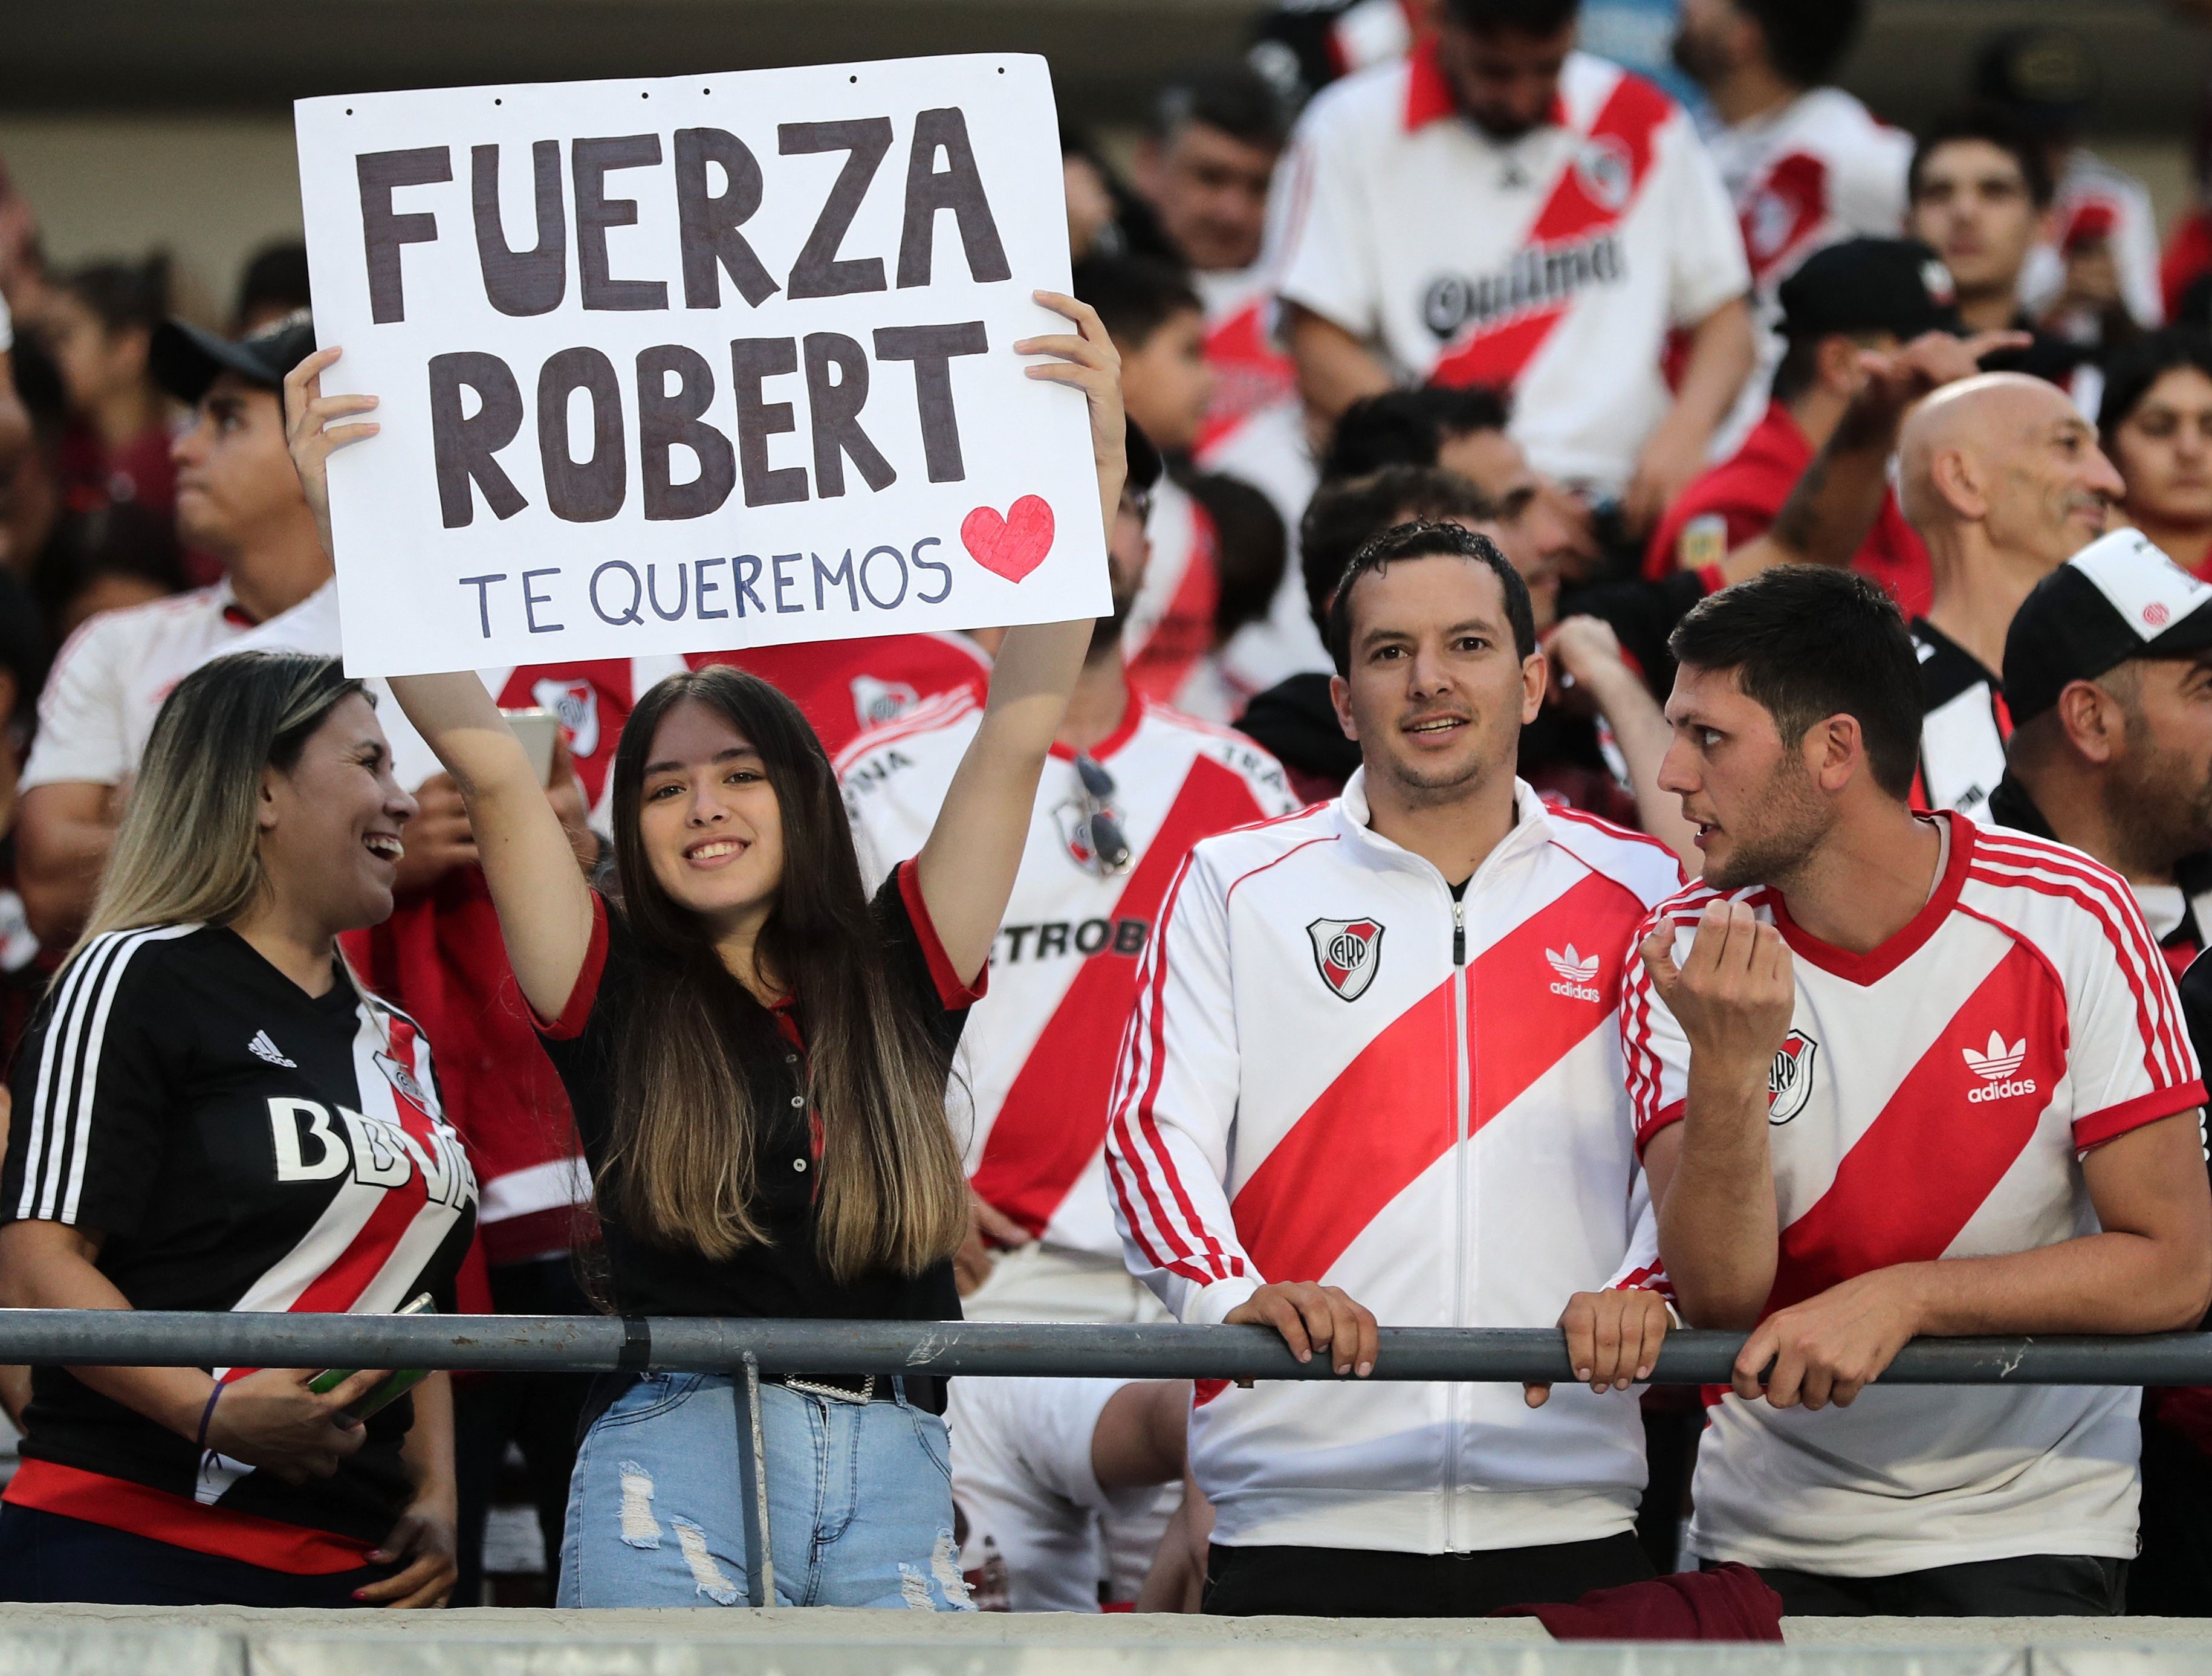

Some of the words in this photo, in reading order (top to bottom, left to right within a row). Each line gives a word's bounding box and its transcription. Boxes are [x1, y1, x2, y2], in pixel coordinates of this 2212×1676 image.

[355, 107, 1011, 325] FUERZA
[428, 321, 988, 528] ROBERT
[459, 568, 564, 638] TE
[590, 537, 952, 626] QUEREMOS
[989, 919, 1147, 968] TROB
[1329, 934, 1366, 968] CARP
[1550, 982, 1600, 1003] adidas
[248, 1047, 297, 1068] adidas
[1968, 1079, 2036, 1103] adidas
[267, 1097, 478, 1212] BBVA
